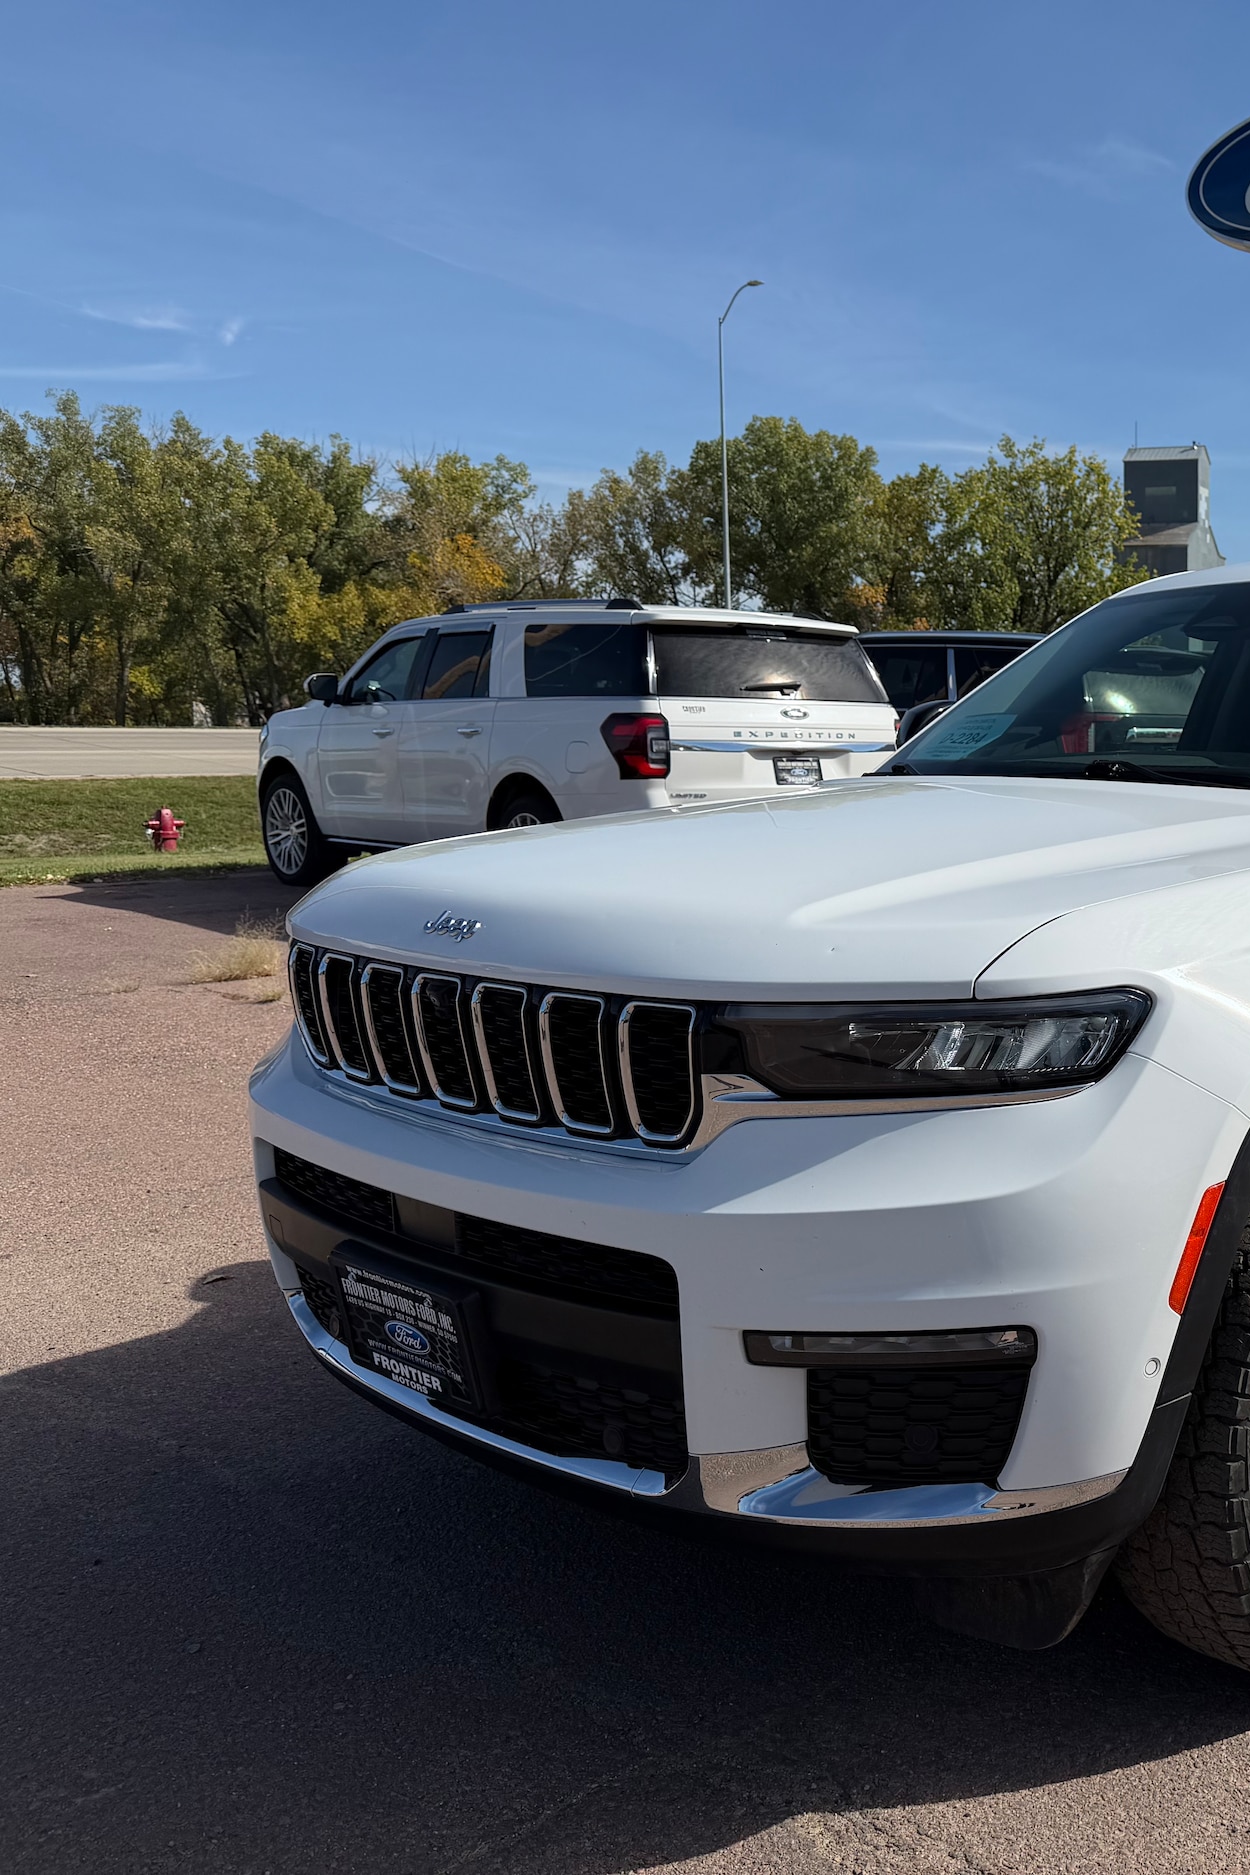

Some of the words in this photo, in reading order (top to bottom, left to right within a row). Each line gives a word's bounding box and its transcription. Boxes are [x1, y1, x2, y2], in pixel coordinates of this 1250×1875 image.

[733, 730, 857, 740] EXPEDITION
[669, 792, 708, 800] LIMITED
[423, 910, 482, 943] Jeep
[341, 1277, 382, 1308] FRONTIER
[381, 1290, 416, 1317] MOTORS
[394, 1325, 423, 1350] Ford
[372, 1351, 443, 1393] FRONTIER
[391, 1373, 429, 1395] MOTORS
